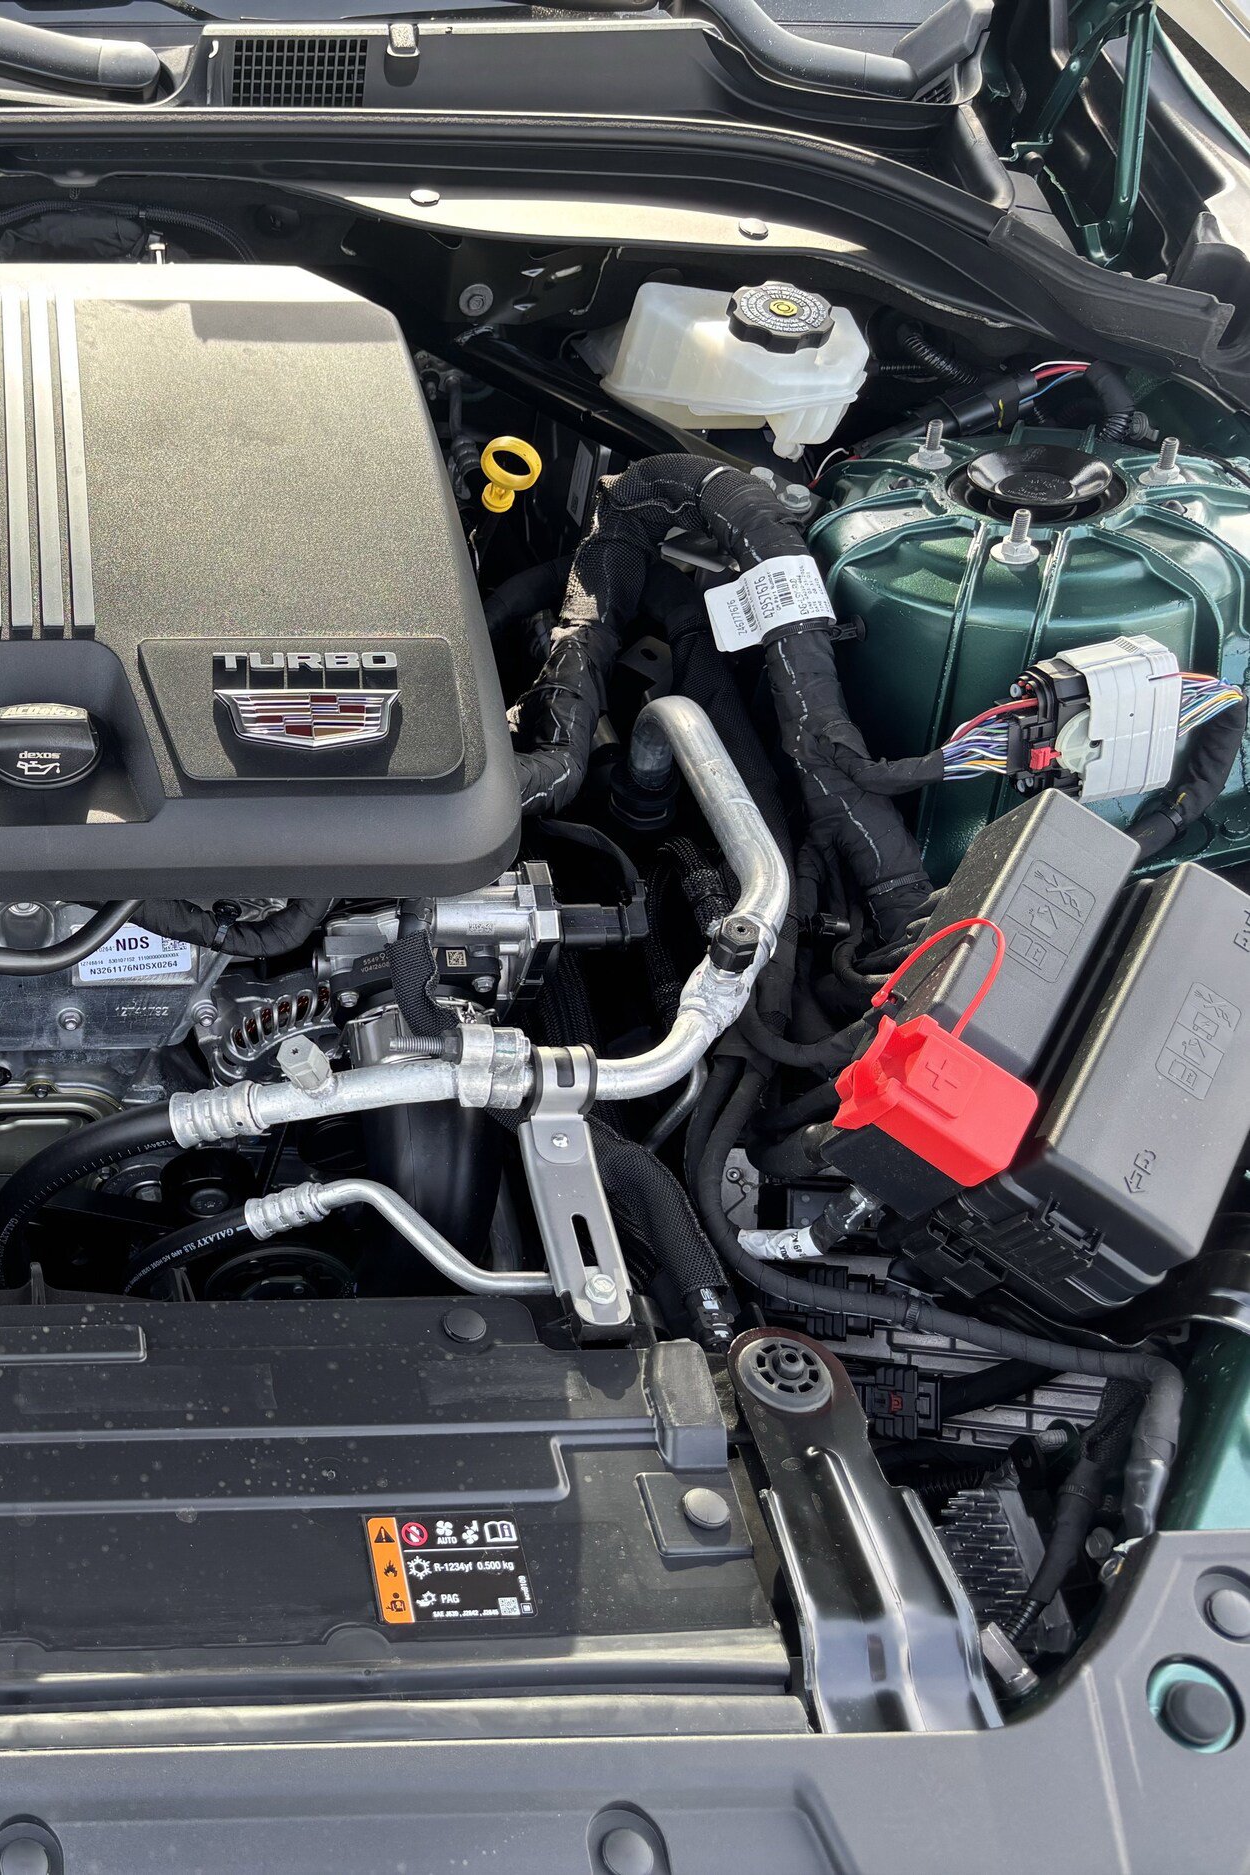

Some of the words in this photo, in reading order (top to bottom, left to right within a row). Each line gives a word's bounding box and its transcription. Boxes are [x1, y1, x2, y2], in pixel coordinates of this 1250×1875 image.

[753, 575, 774, 619] 42957676
[212, 651, 400, 672] TURBO
[2, 704, 79, 719] ACDelco
[18, 751, 60, 760] dexos
[115, 935, 150, 952] NDS
[90, 960, 178, 976] N3261176NDSX0264
[196, 1227, 235, 1249] GALAXY
[182, 1241, 197, 1254] SLE
[436, 1536, 458, 1545] AUTO
[433, 1561, 472, 1573] R-1234yf
[477, 1560, 501, 1571] 0.500
[502, 1560, 515, 1571] kg
[440, 1593, 460, 1604] PAG
